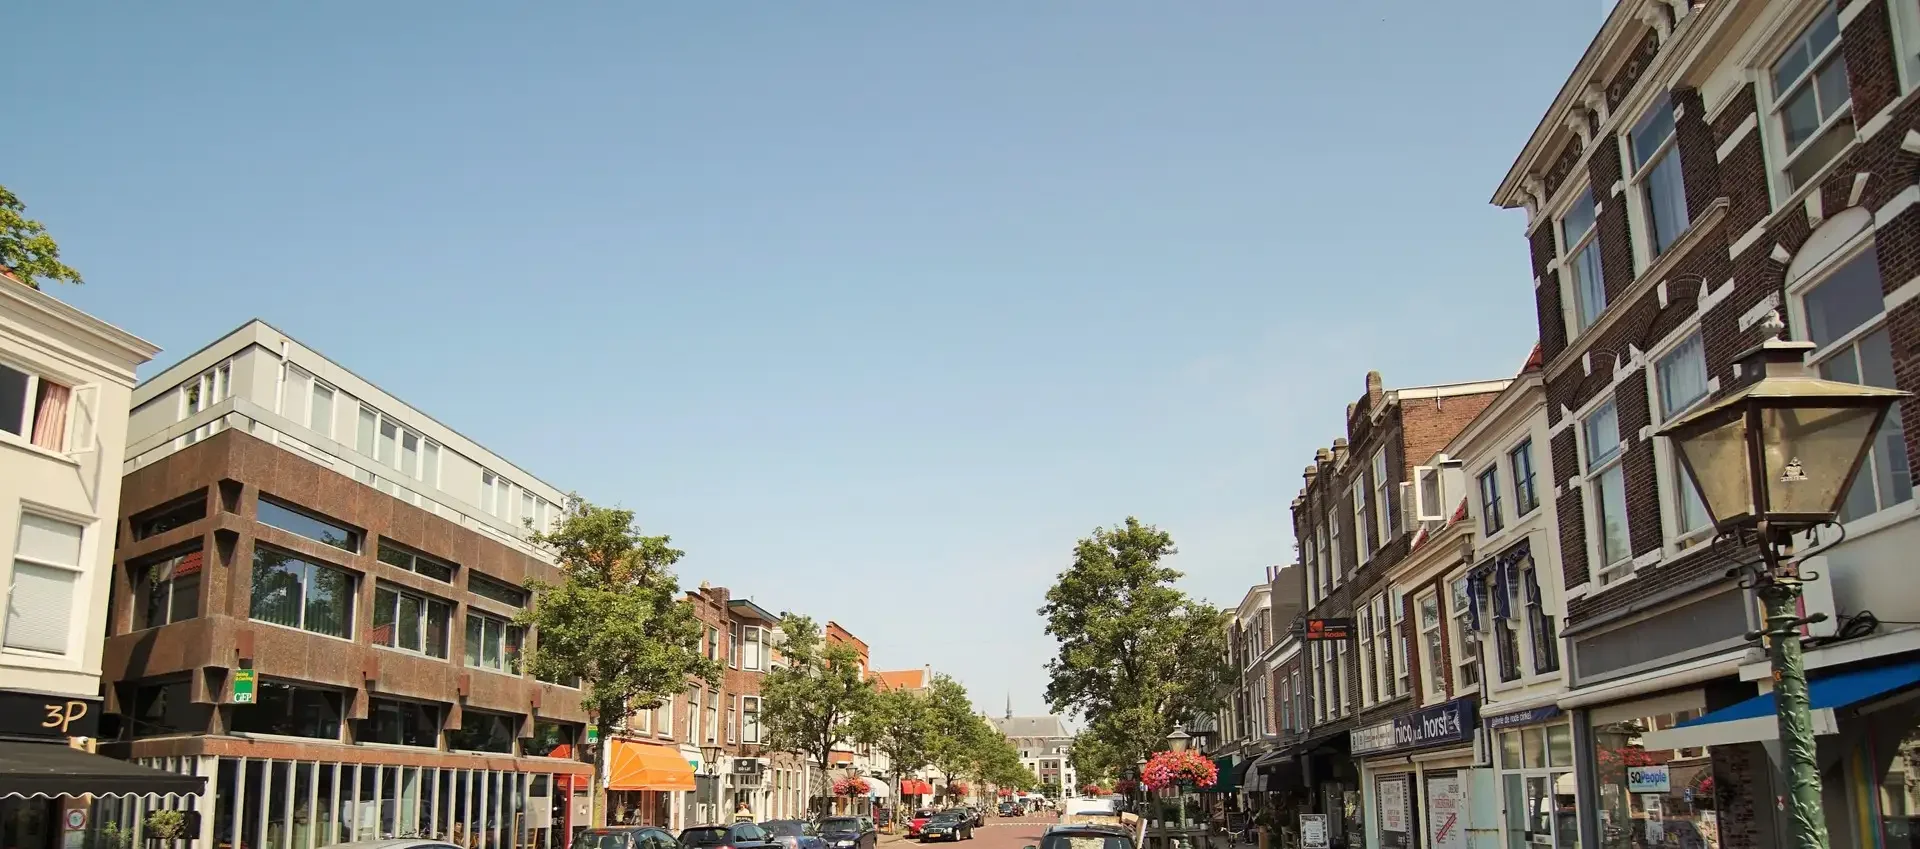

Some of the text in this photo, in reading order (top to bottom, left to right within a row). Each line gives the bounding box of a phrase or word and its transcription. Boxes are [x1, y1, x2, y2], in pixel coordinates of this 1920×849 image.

[42, 701, 88, 732] 3P
[1395, 721, 1413, 744] nico
[1423, 710, 1448, 739] horst
